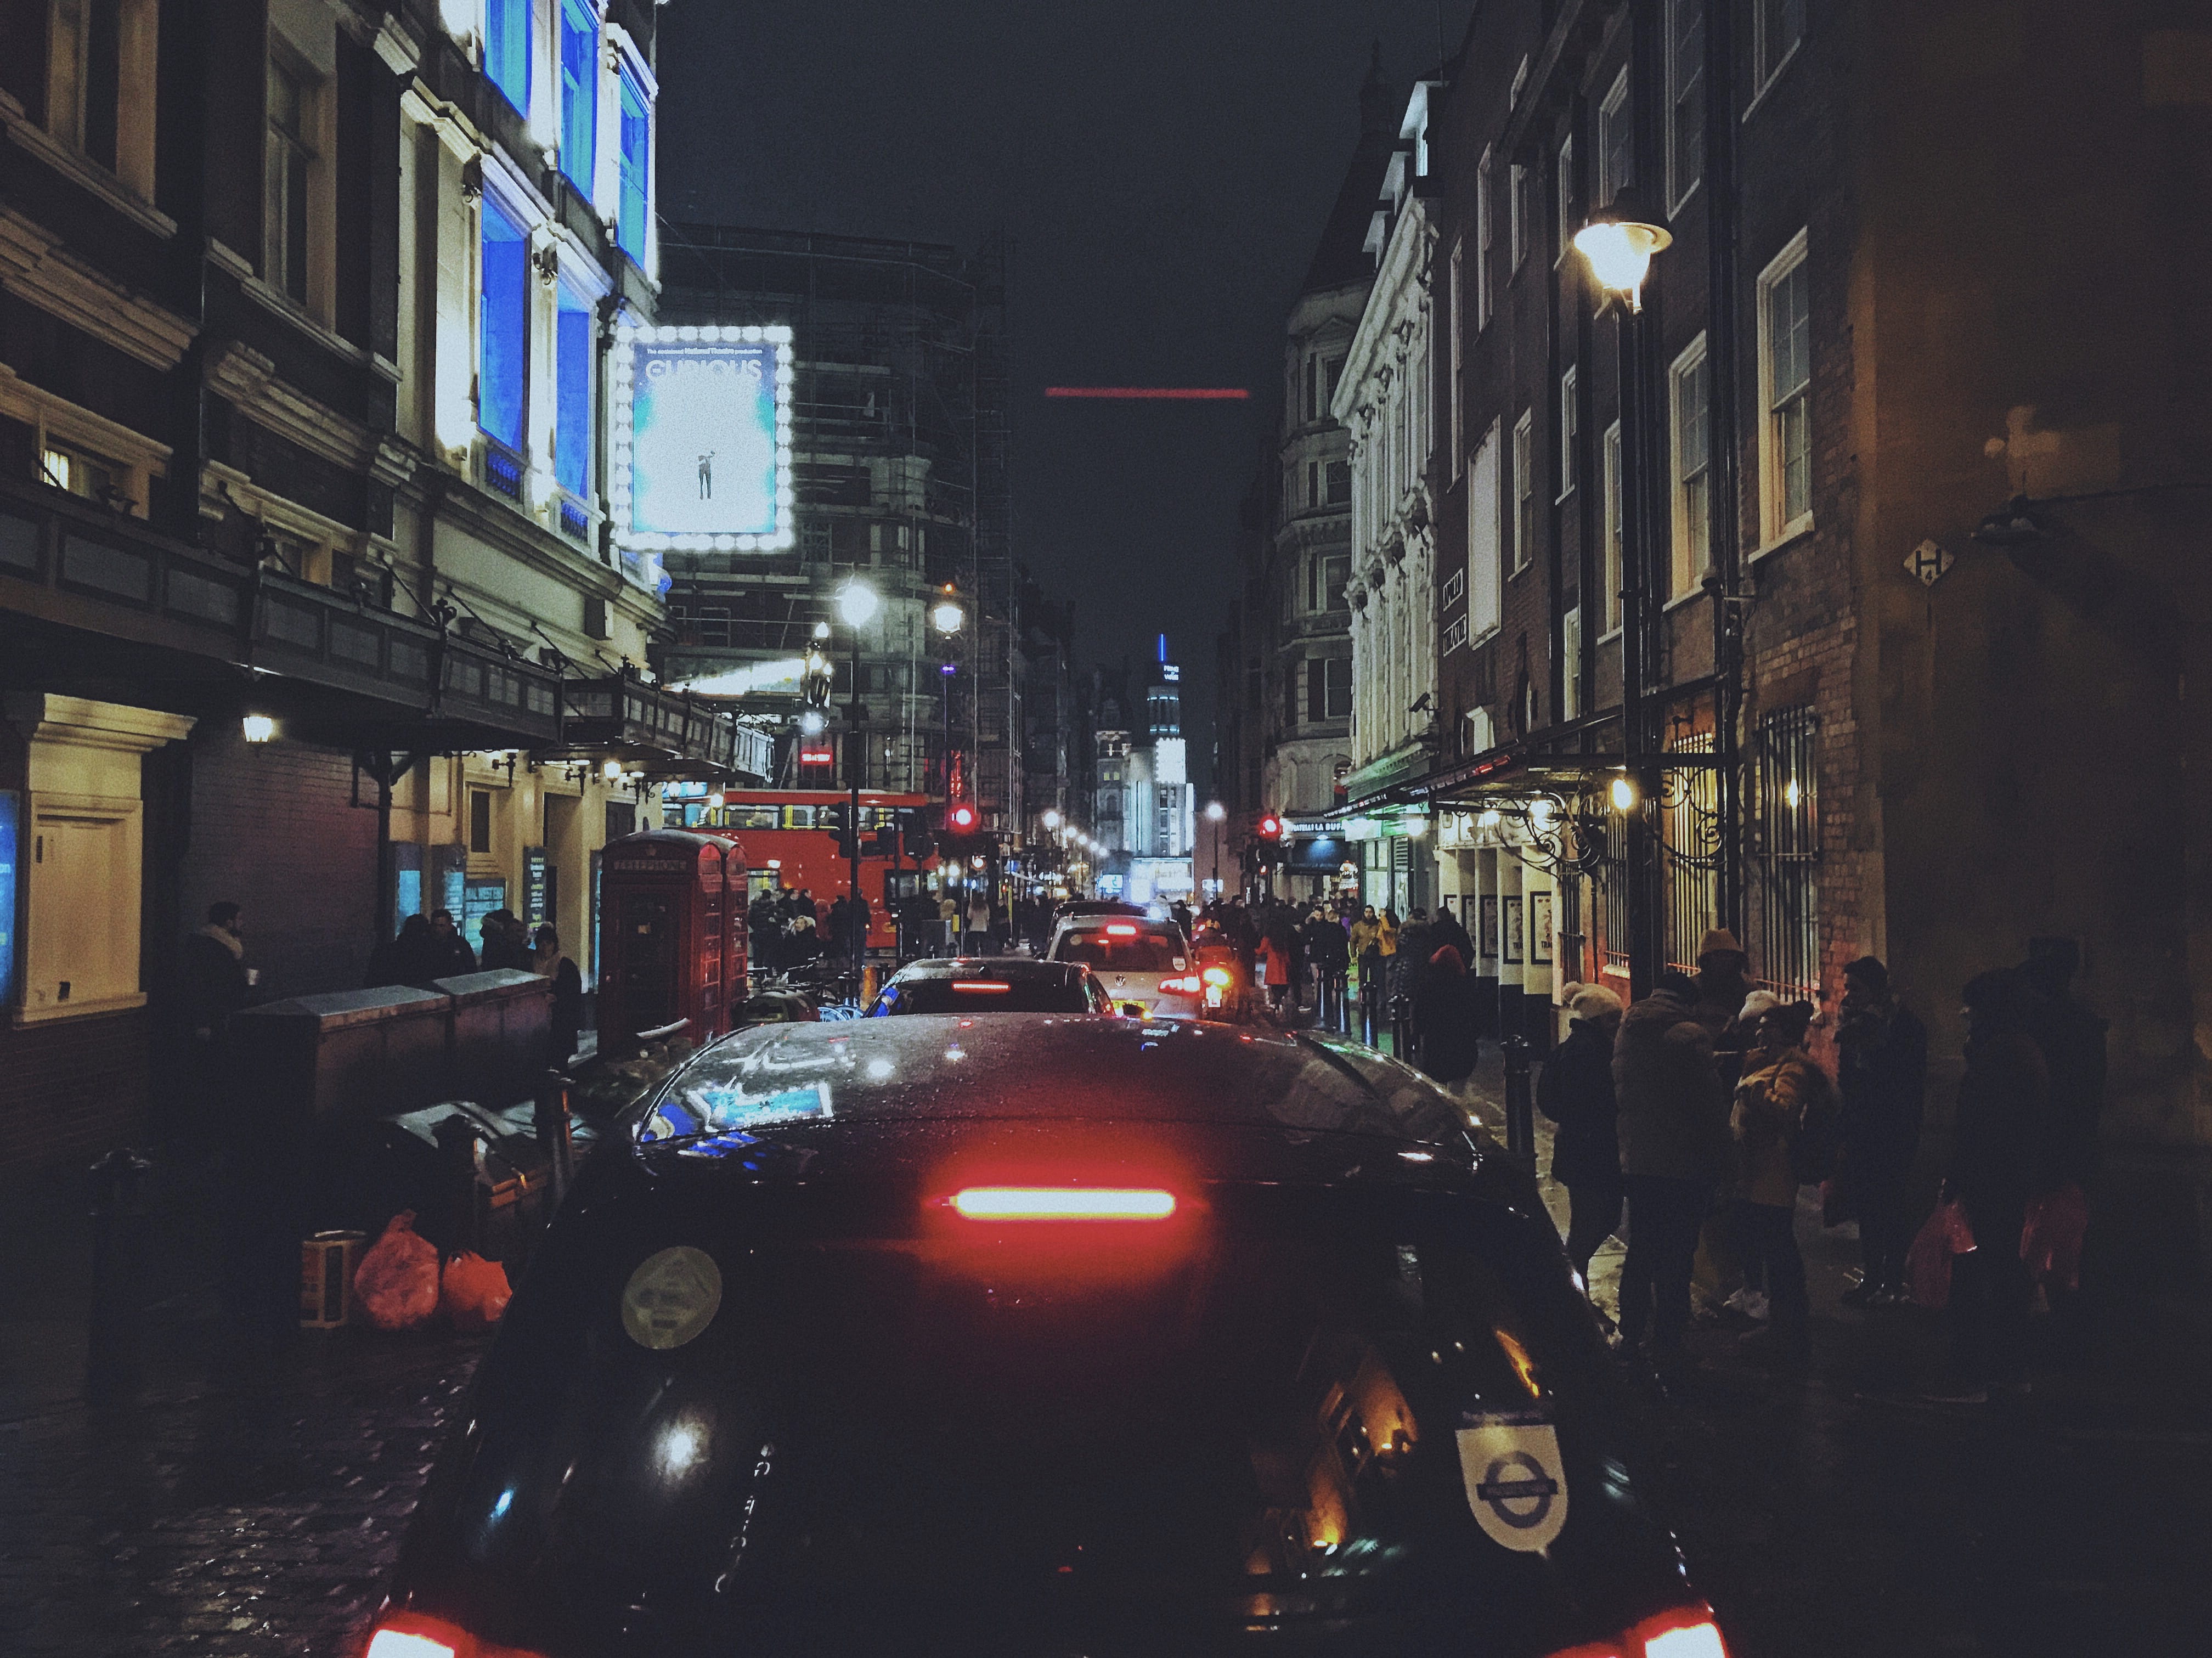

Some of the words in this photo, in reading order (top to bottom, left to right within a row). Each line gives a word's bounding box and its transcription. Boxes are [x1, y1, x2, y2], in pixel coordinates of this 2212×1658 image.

[1916, 549, 1942, 577] H
[1443, 572, 1462, 610] APOLLO
[1314, 823, 1324, 831] LA
